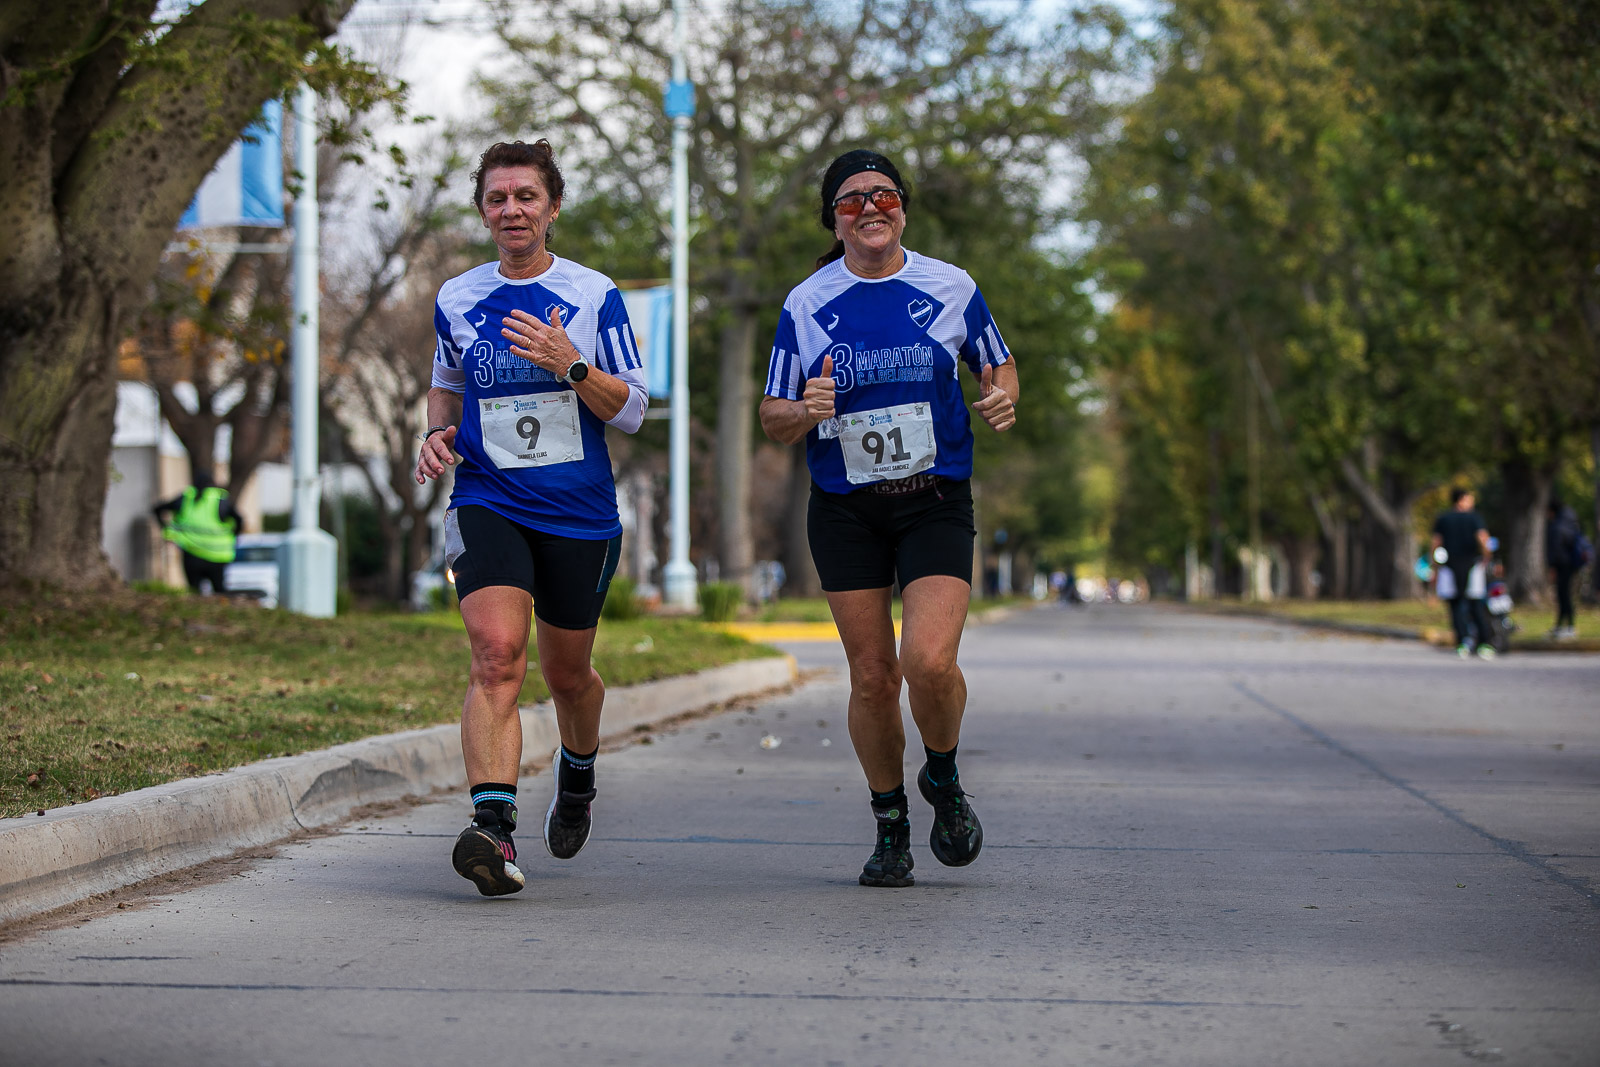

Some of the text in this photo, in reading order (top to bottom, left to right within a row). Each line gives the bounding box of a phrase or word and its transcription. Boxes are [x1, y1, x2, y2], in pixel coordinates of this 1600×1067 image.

[474, 340, 494, 388] 3
[830, 343, 854, 393] 3
[856, 342, 934, 372] MARATÓN
[514, 400, 520, 412] 3
[869, 414, 875, 426] 3
[516, 416, 540, 450] 9
[862, 427, 912, 464] 91
